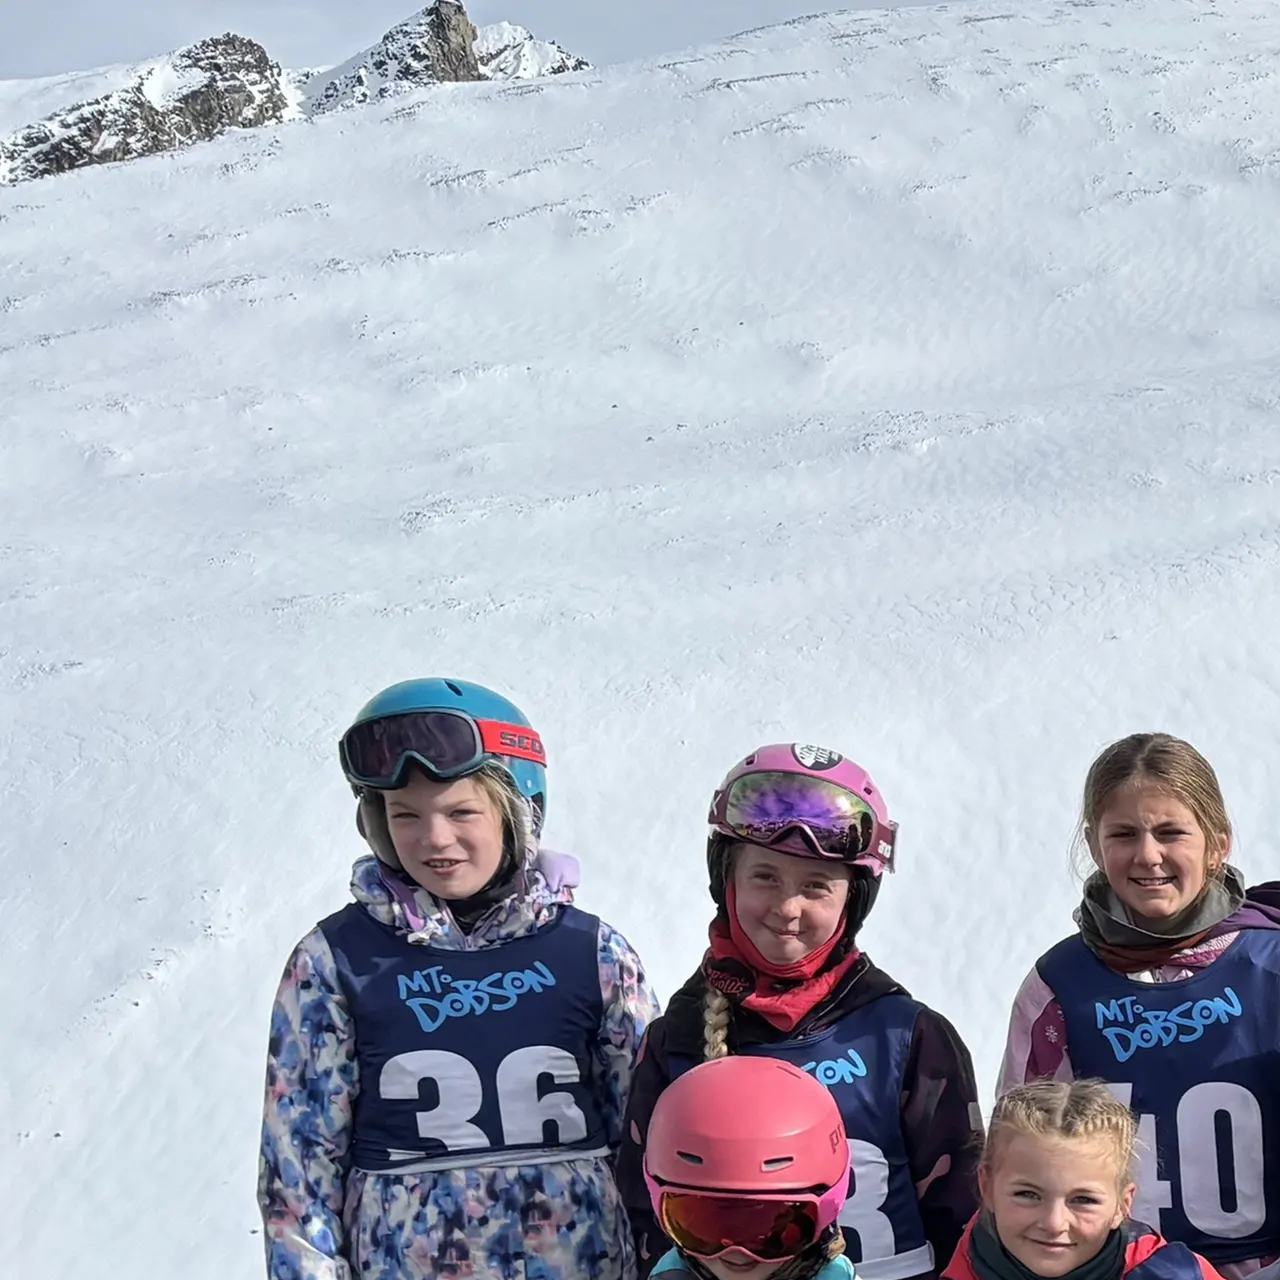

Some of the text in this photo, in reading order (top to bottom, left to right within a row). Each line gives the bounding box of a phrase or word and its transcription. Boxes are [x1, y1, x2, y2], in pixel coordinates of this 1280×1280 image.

[405, 960, 557, 1033] DOBSON
[1102, 987, 1243, 1063] DOBSON
[380, 1045, 588, 1160] 36
